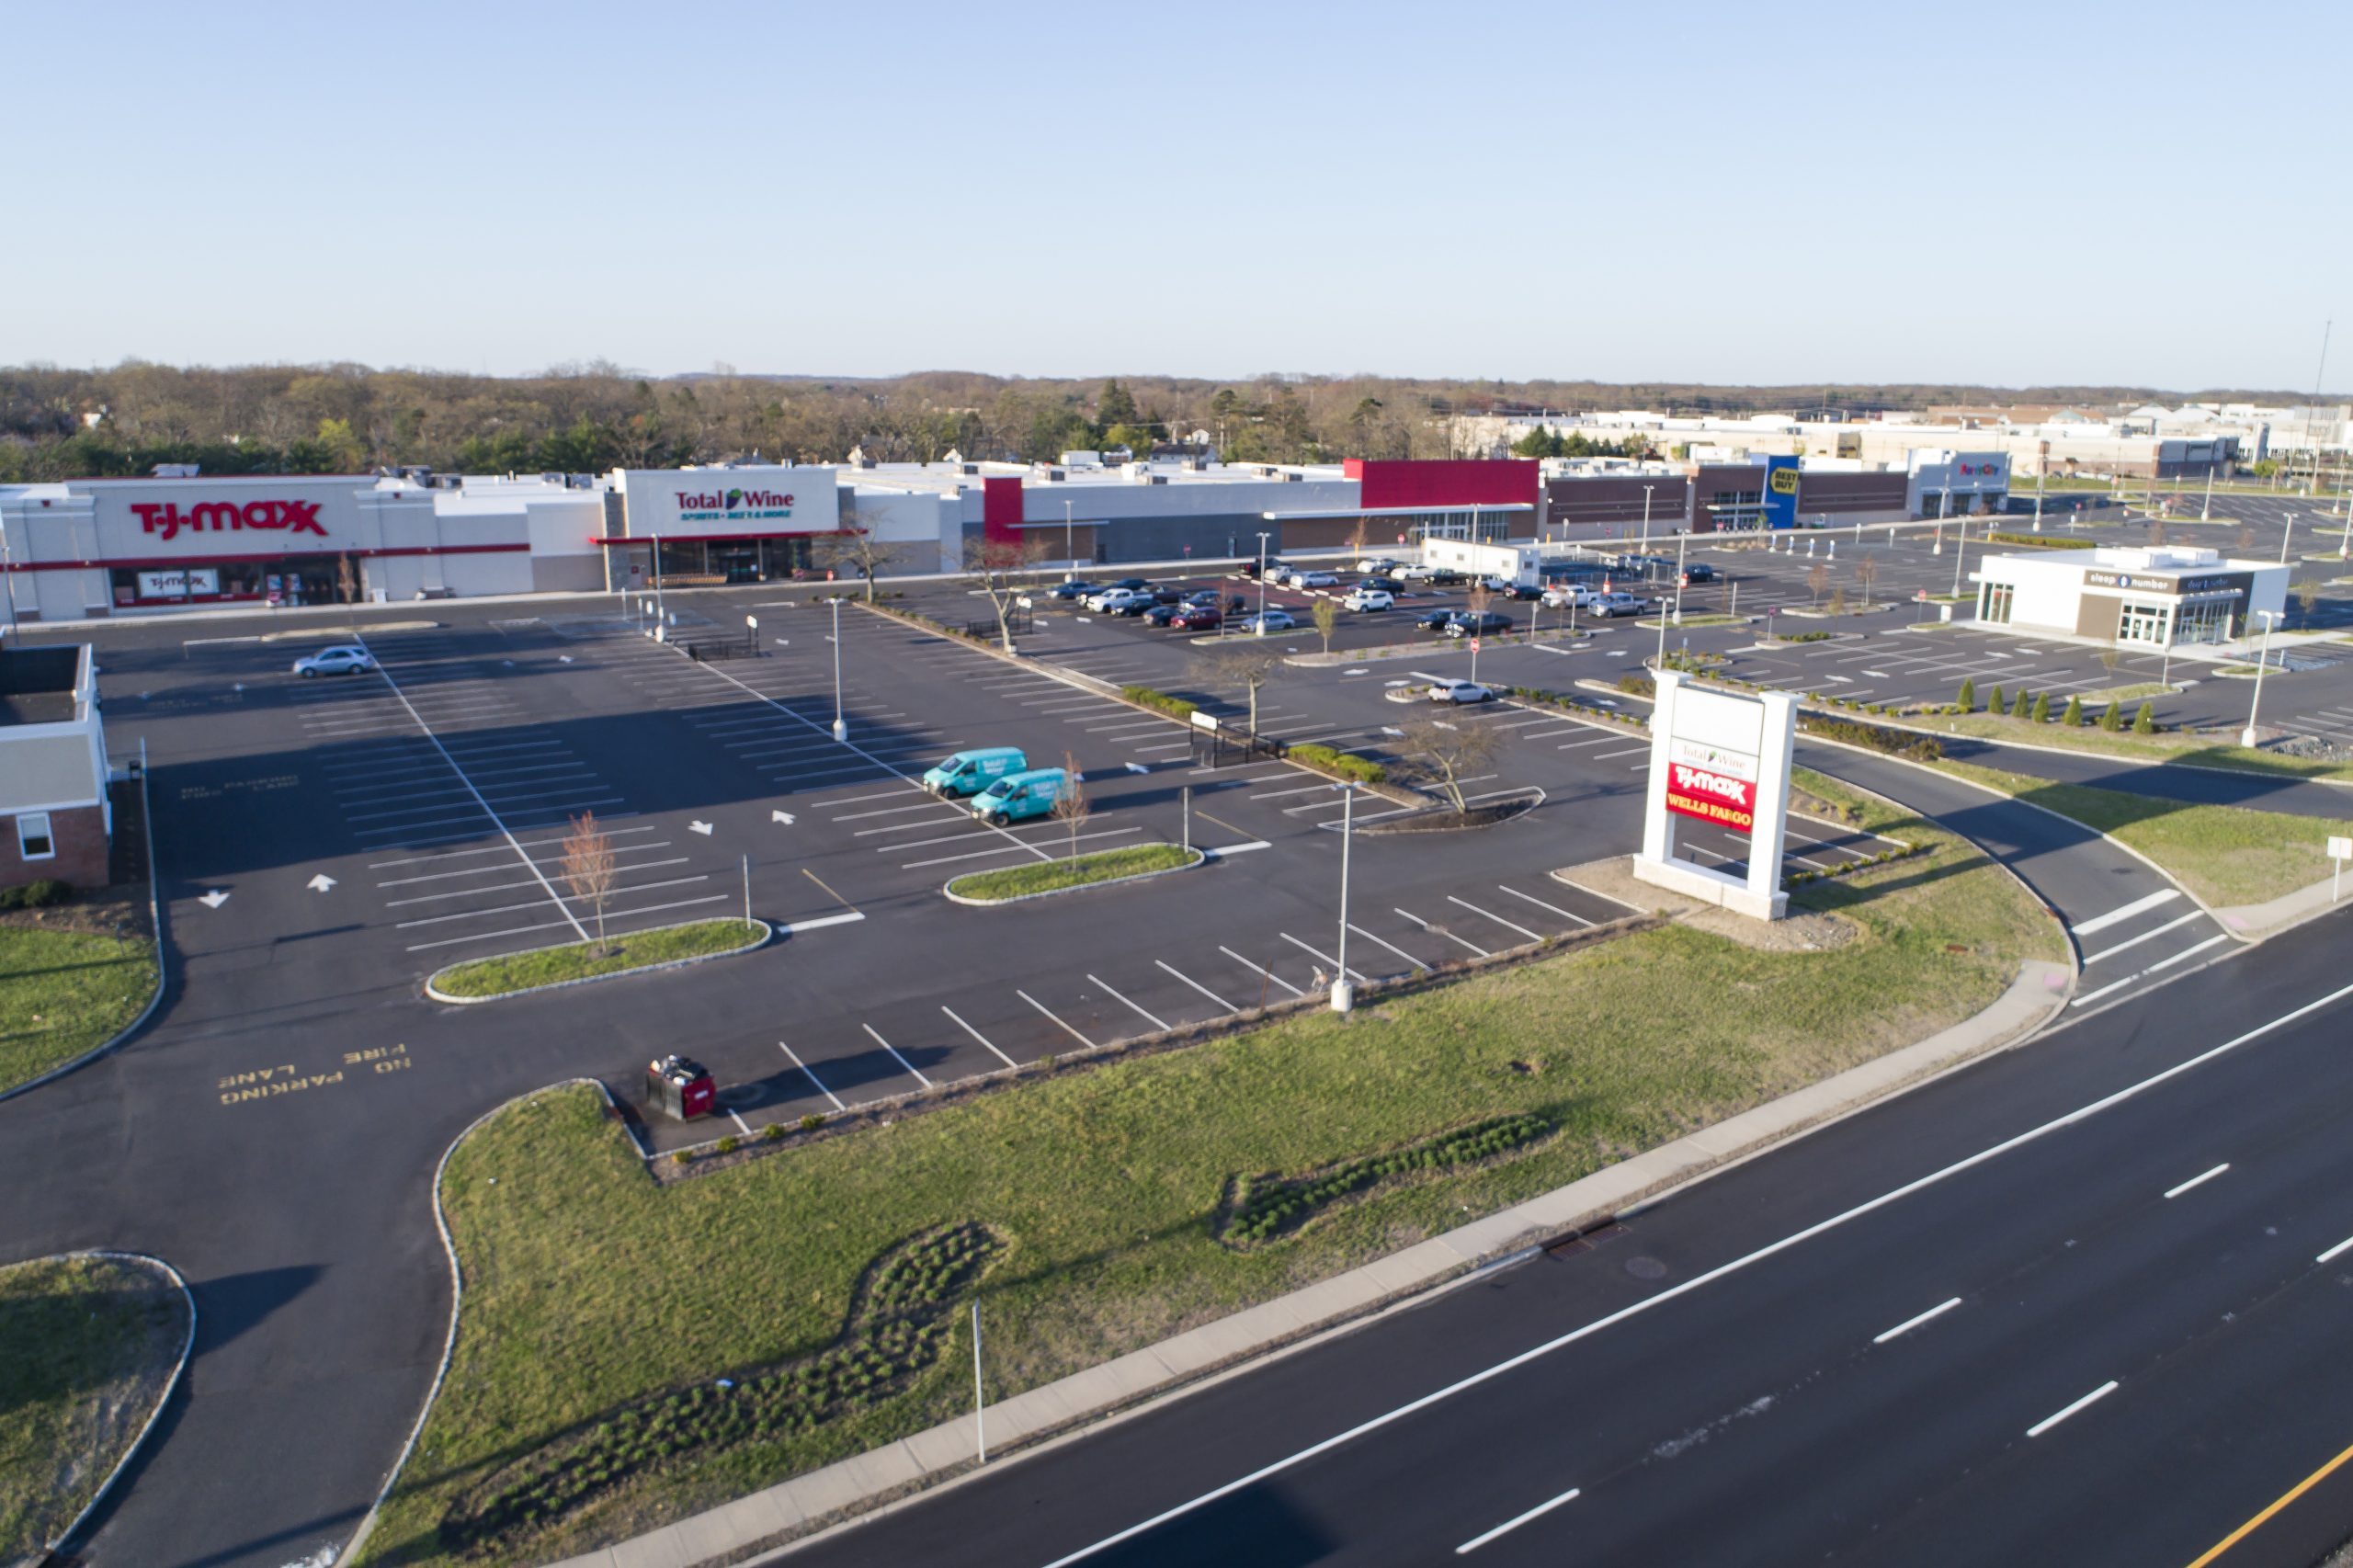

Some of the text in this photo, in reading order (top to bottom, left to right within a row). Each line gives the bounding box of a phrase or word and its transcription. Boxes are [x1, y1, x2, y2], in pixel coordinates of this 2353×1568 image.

[1775, 471, 1796, 482] BEST
[1775, 479, 1794, 490] BUY
[675, 490, 794, 509] Total Wine
[2088, 573, 2168, 589] sleep number
[1718, 753, 1745, 768] Wine
[1668, 793, 1751, 826] WELLS FARGO
[218, 1043, 406, 1089] FIRE LANE
[220, 1057, 411, 1104] NO PARKING
